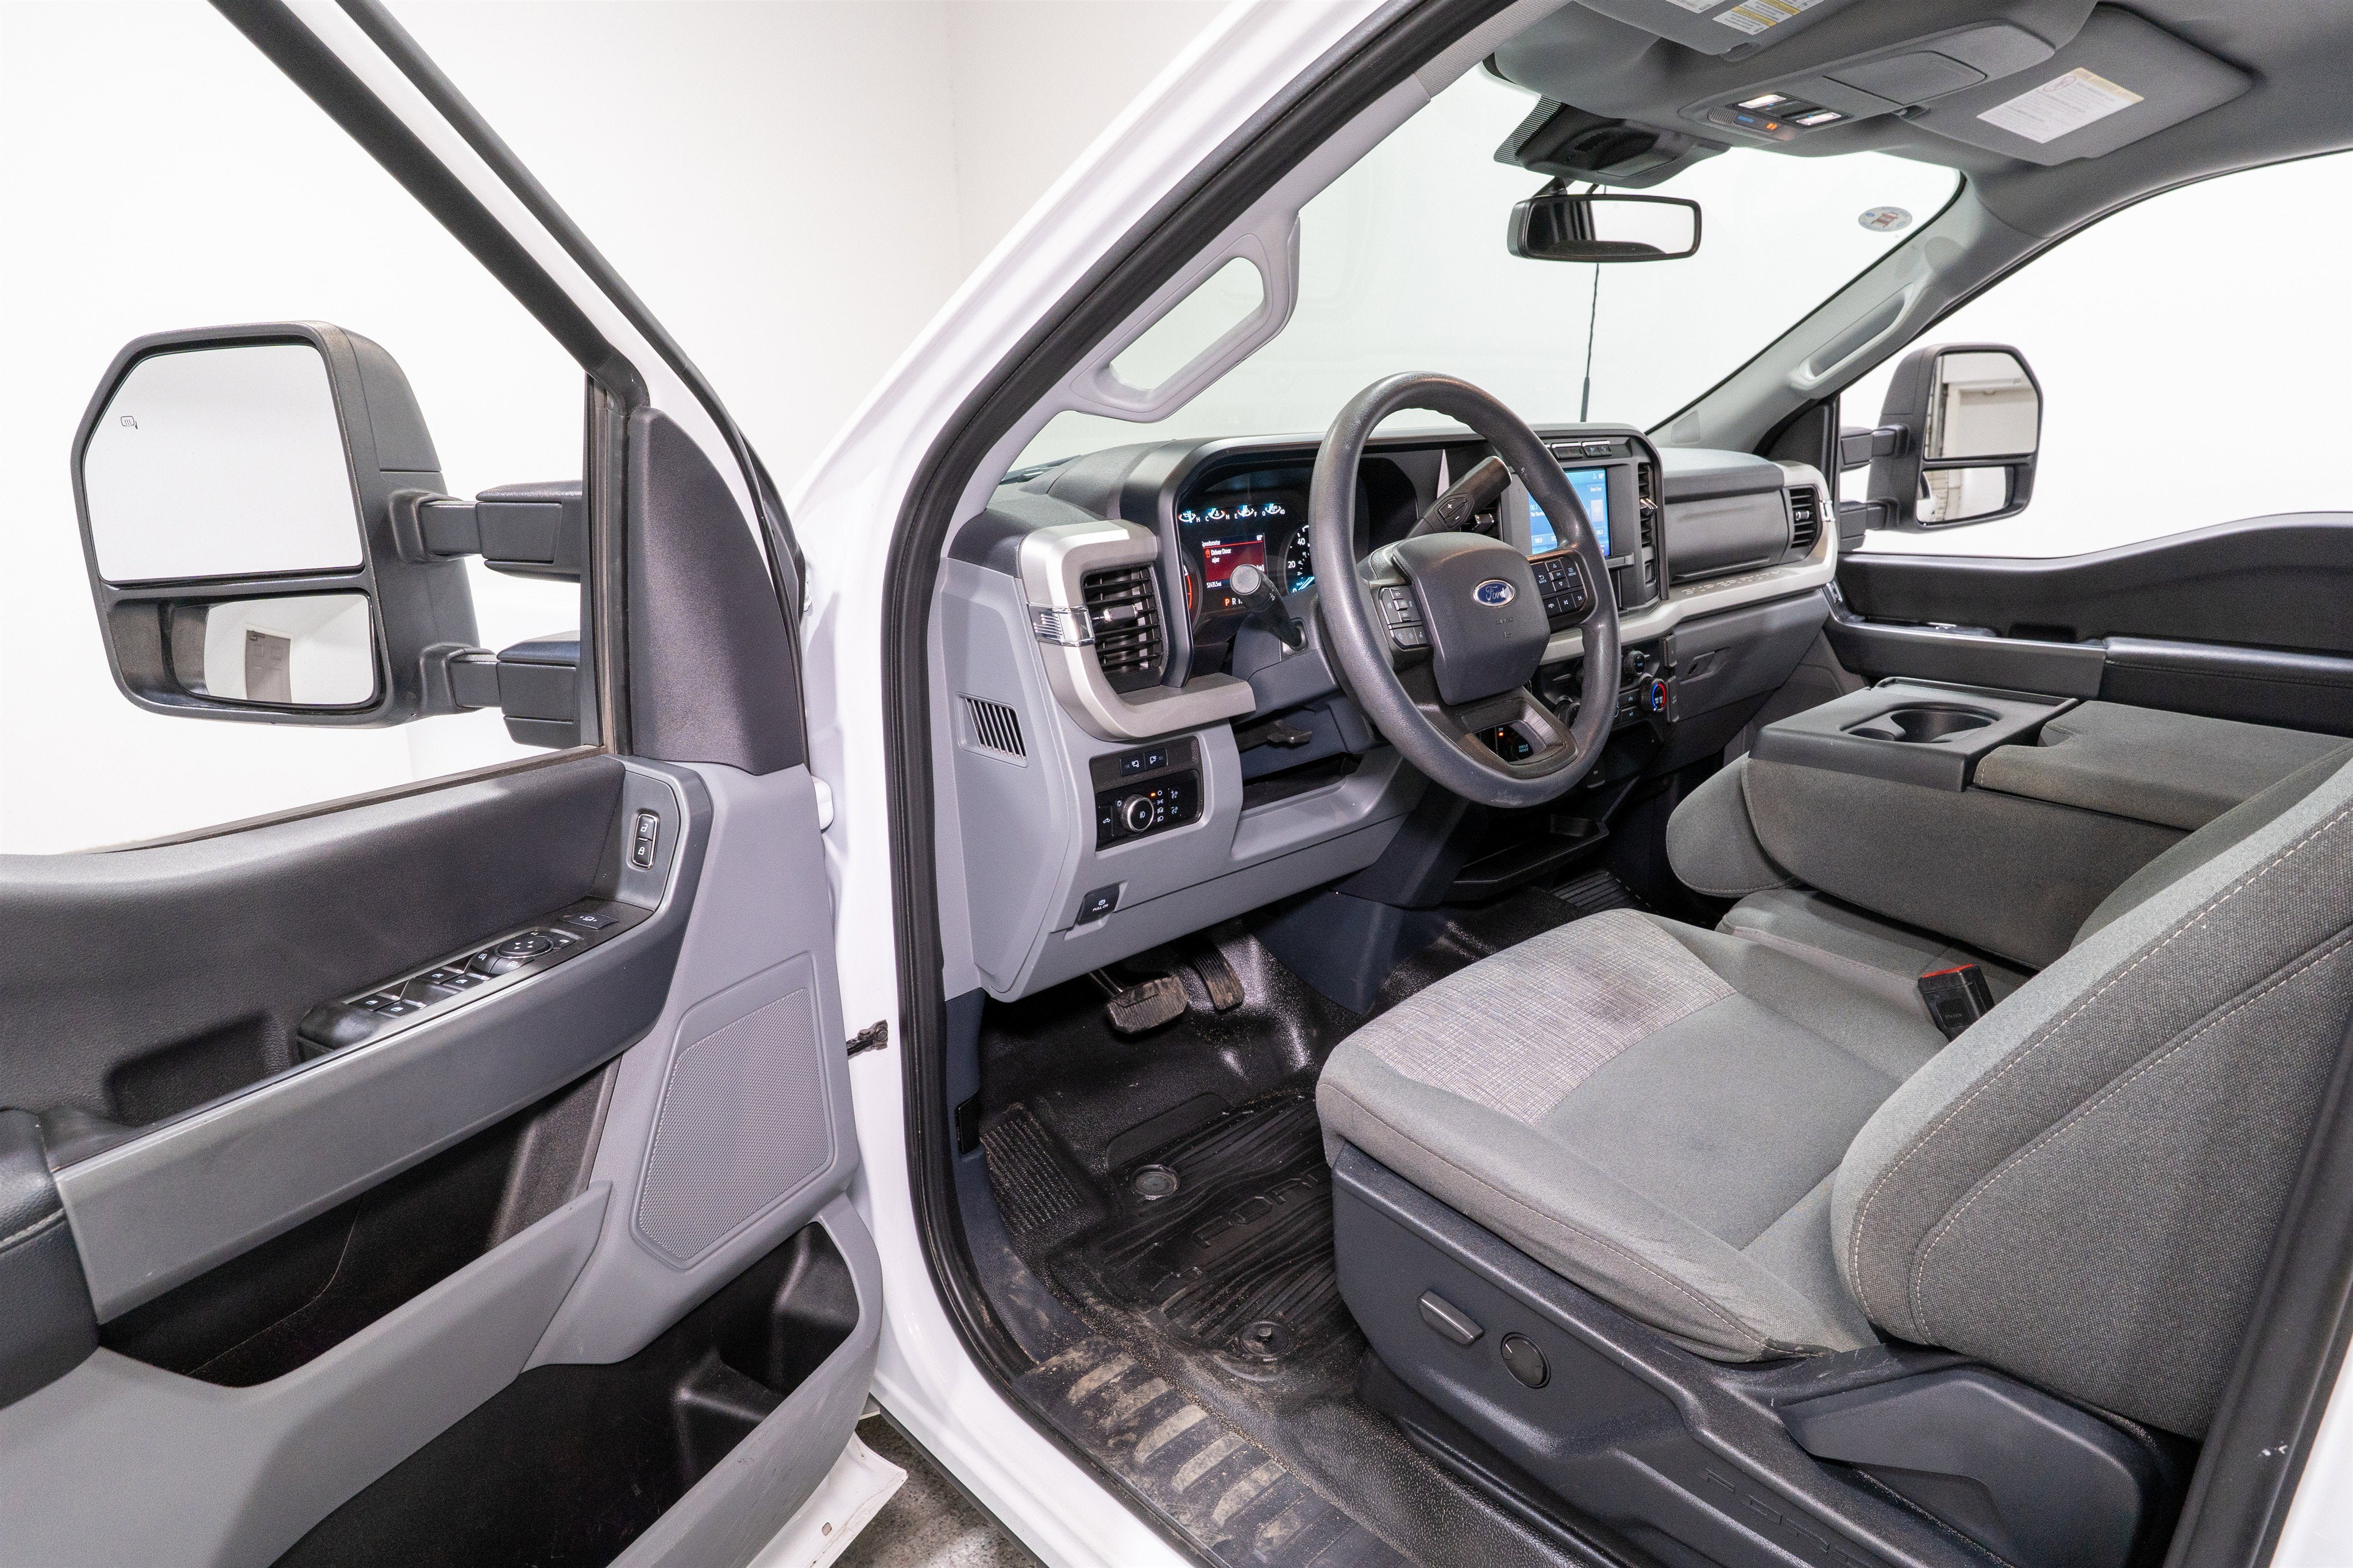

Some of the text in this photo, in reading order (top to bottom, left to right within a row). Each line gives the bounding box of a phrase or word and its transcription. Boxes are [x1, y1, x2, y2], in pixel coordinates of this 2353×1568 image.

[1288, 561, 1296, 569] 20
[1486, 585, 1506, 601] Ford
[1225, 598, 1230, 607] P
